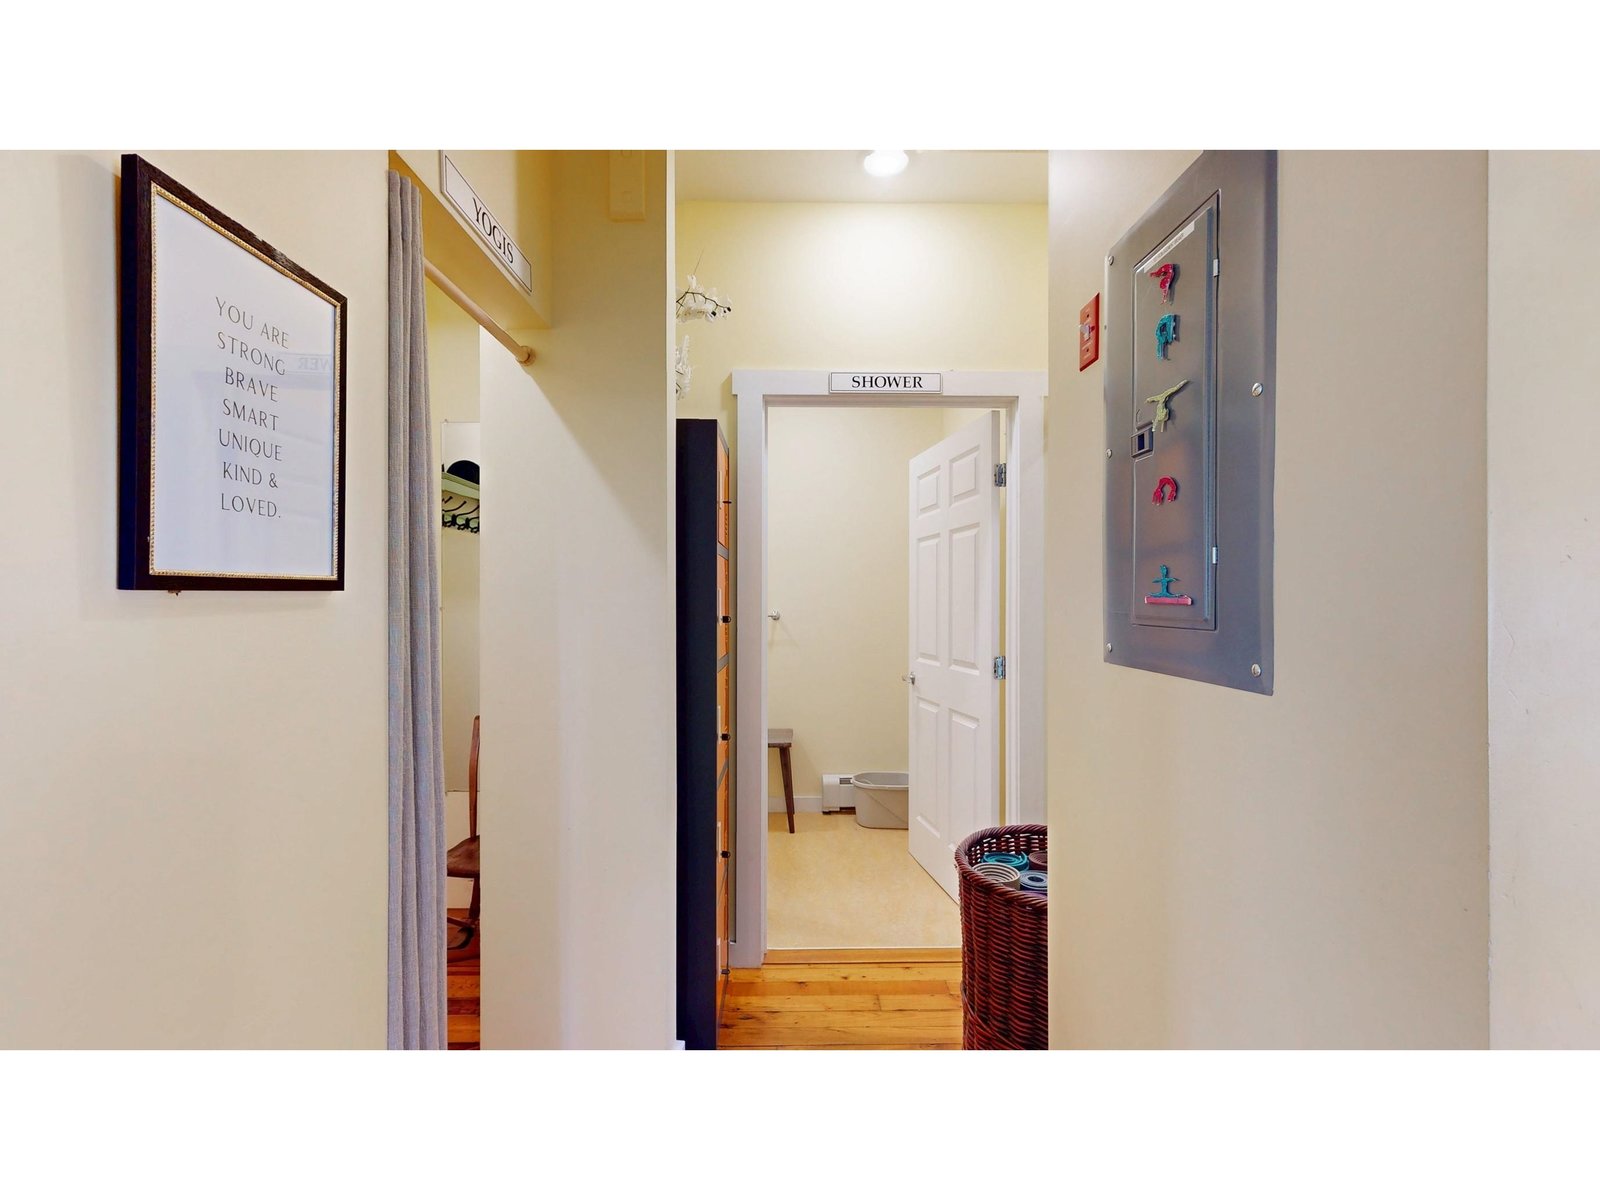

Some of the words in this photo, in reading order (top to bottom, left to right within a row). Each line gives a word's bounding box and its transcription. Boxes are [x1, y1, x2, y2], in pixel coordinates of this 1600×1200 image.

[473, 197, 513, 264] YOGIS
[216, 296, 253, 330] YOU
[260, 323, 289, 349] ARE
[217, 331, 285, 376] STRONG
[225, 366, 278, 403] BRAVE
[851, 375, 923, 388] SHOWER
[222, 398, 279, 431] SMART
[219, 428, 282, 461] UNIQUE
[223, 461, 262, 485] KIND
[268, 472, 278, 488] &
[221, 493, 281, 518] LOVED.
